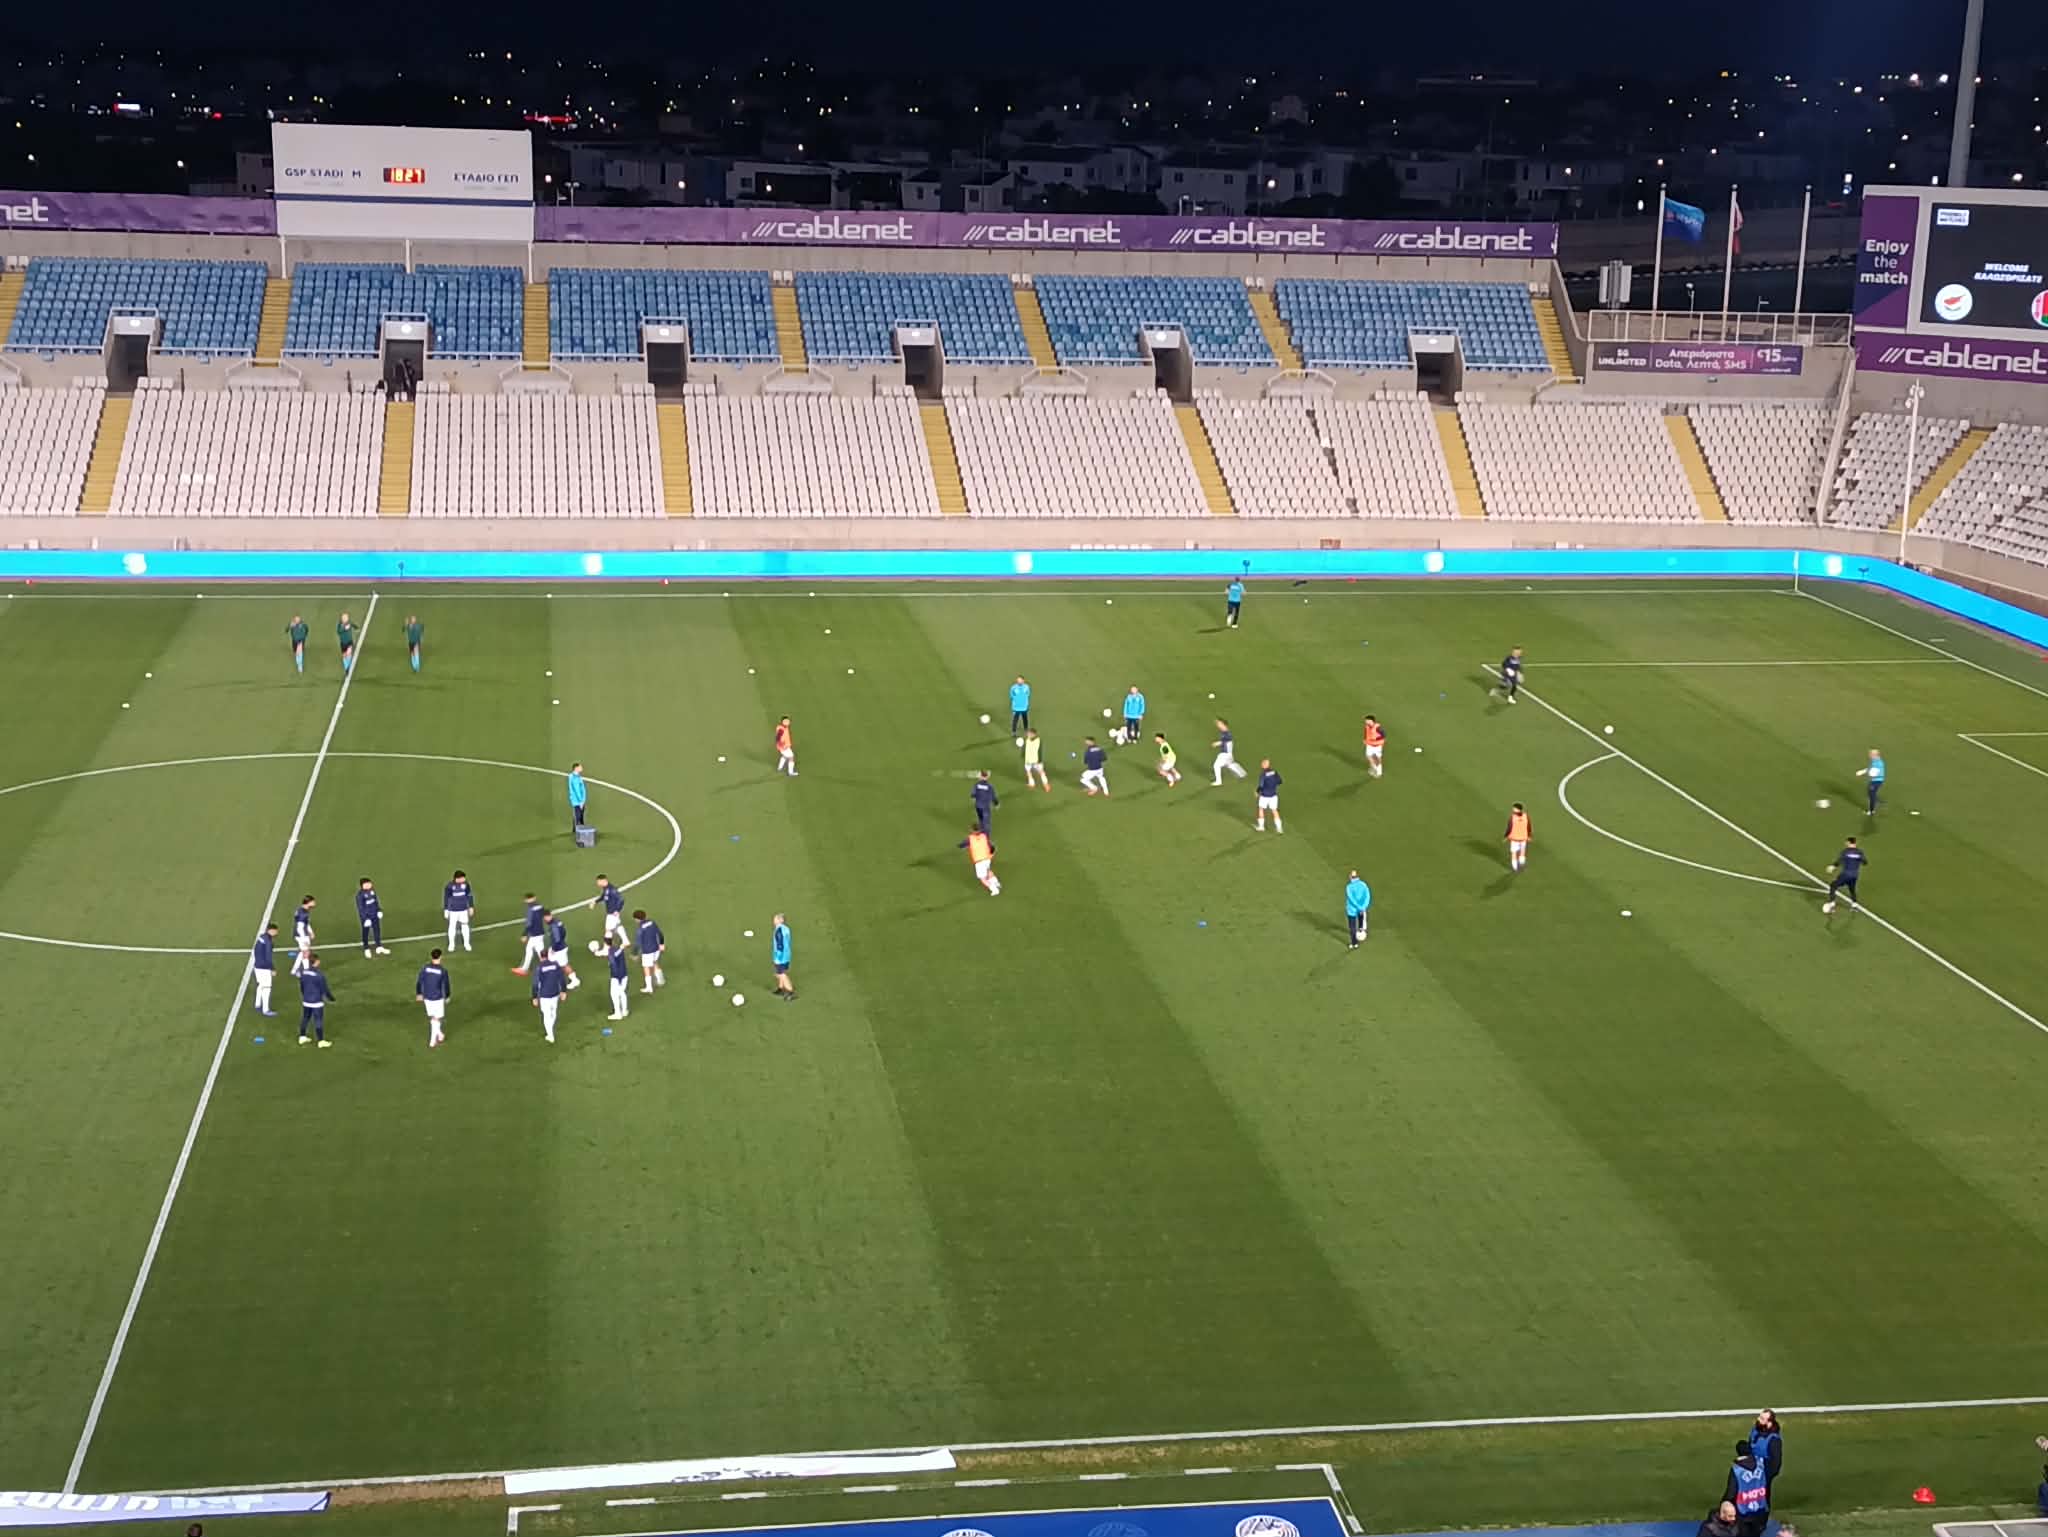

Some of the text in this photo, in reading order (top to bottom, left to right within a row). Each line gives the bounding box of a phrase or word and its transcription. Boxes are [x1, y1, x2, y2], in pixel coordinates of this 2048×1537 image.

[285, 168, 307, 178] GSP
[777, 215, 913, 240] cablenet
[988, 218, 1121, 244] cablenet
[1193, 222, 1326, 247] cablenet
[1400, 226, 1533, 250] cablenet
[1865, 239, 1910, 255] Enjoy
[1874, 255, 1898, 269] the
[1984, 263, 2029, 273] WELCOME
[1860, 271, 1909, 285] match
[1598, 356, 1647, 366] UNLIMITED
[1724, 360, 1747, 369] SMS
[1904, 342, 2048, 375] cablenet
